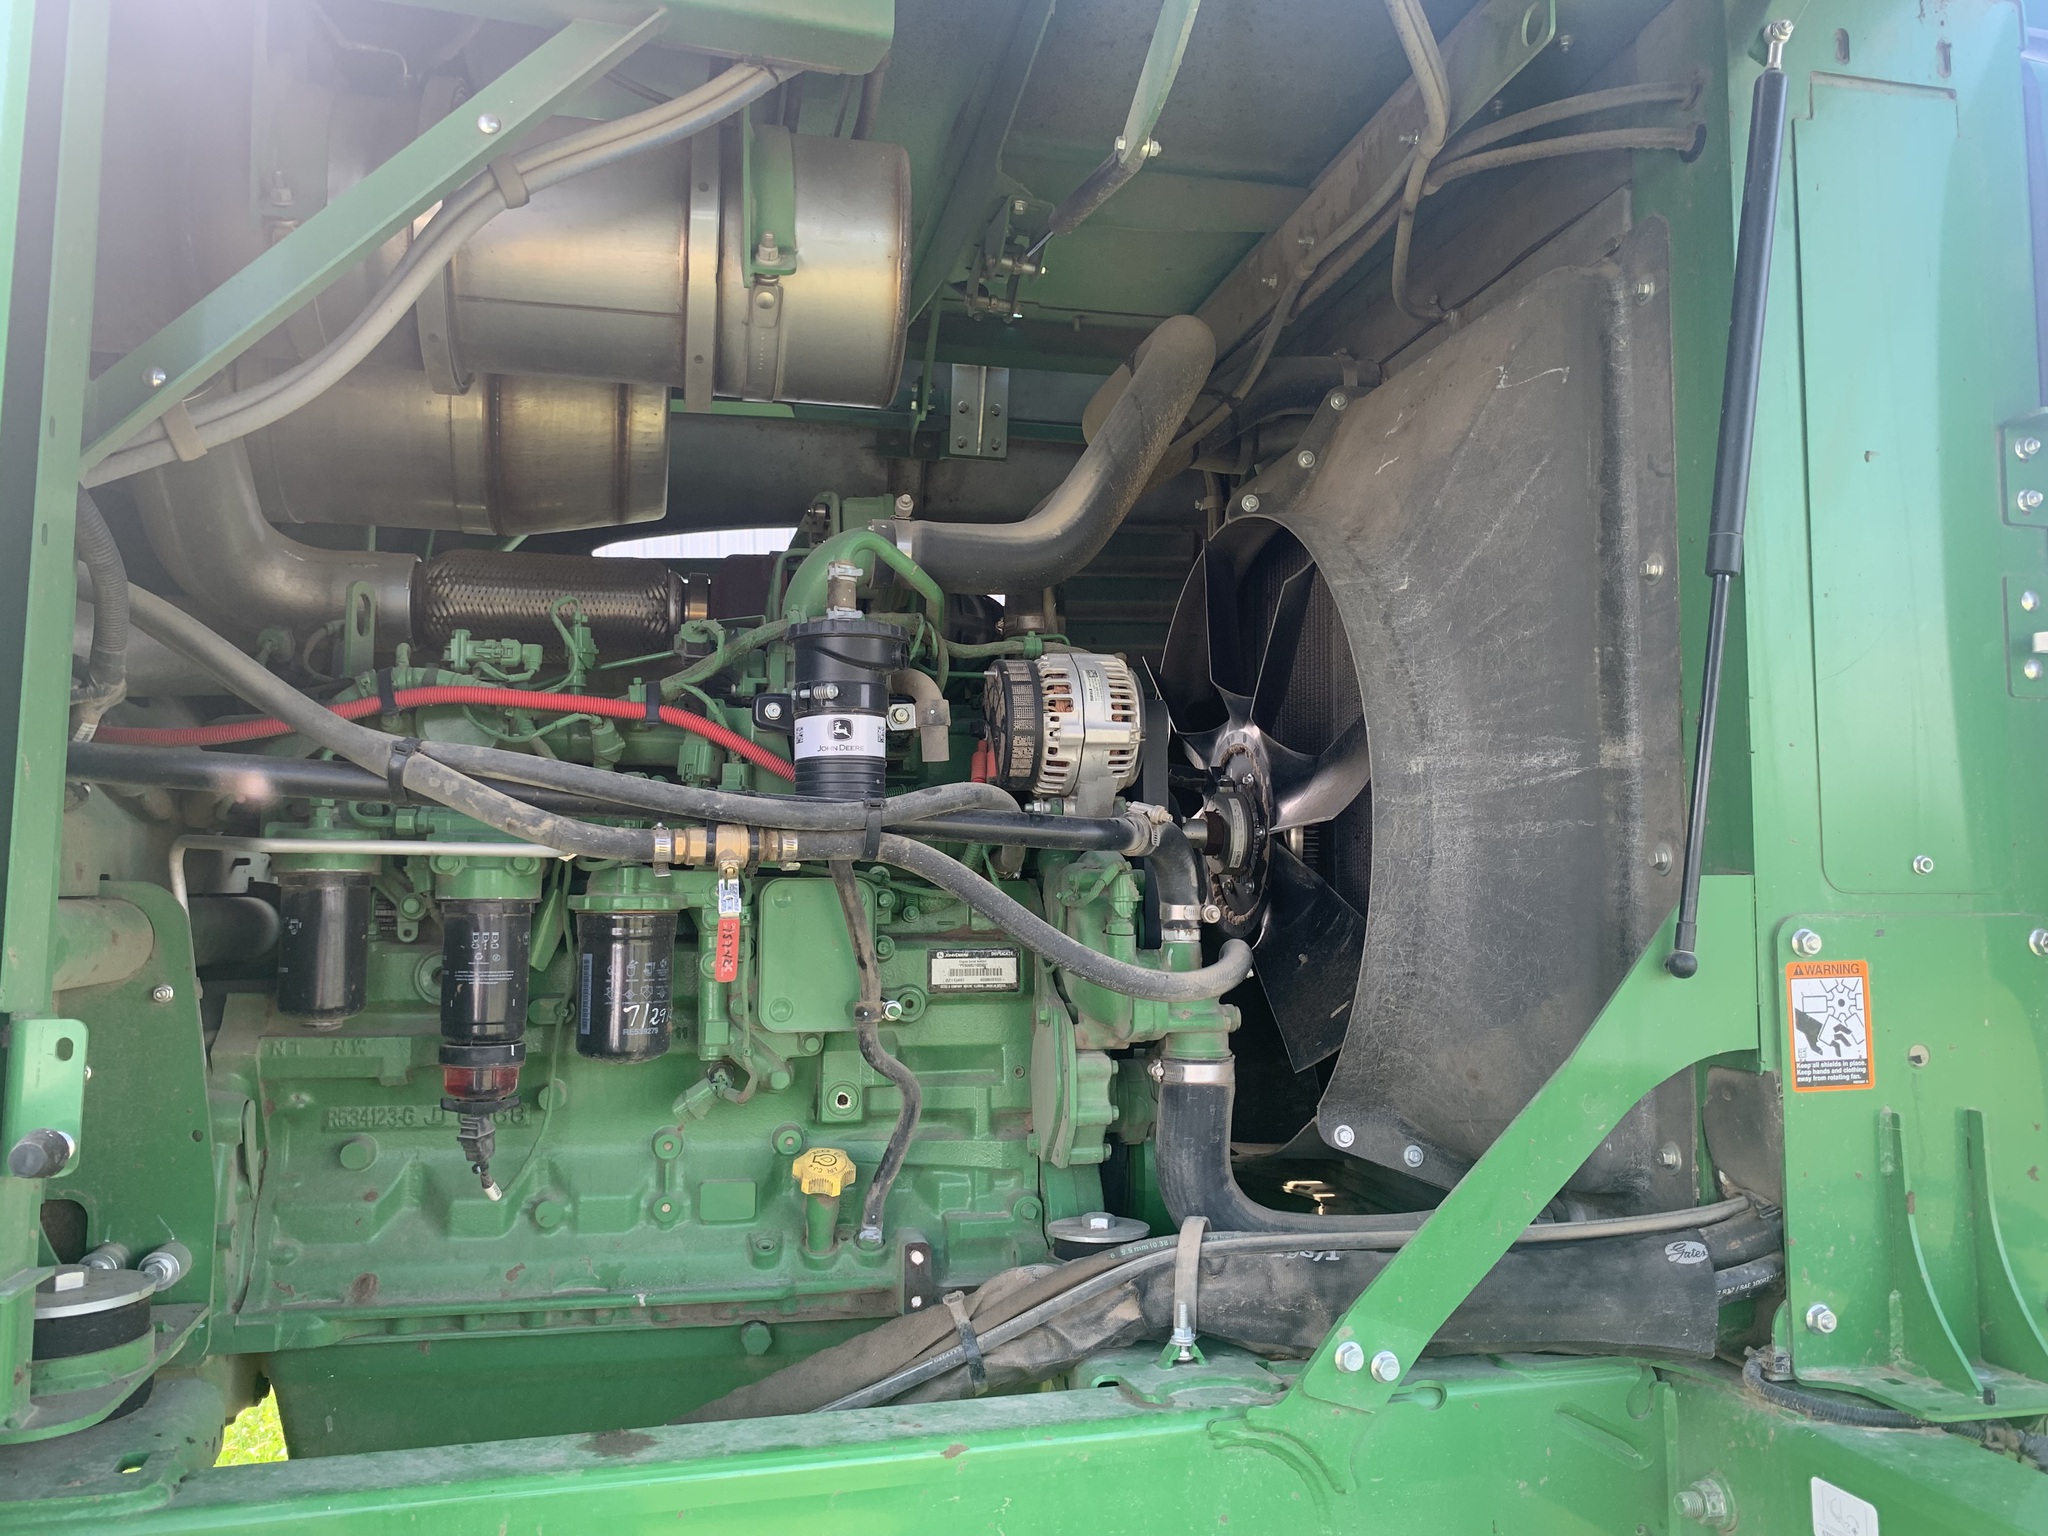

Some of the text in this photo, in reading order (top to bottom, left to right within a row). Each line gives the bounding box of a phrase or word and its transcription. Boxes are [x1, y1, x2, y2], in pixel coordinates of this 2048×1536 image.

[817, 744, 838, 752] JOHN
[1804, 963, 1860, 976] WARNING
[1668, 1242, 1707, 1262] Gates
